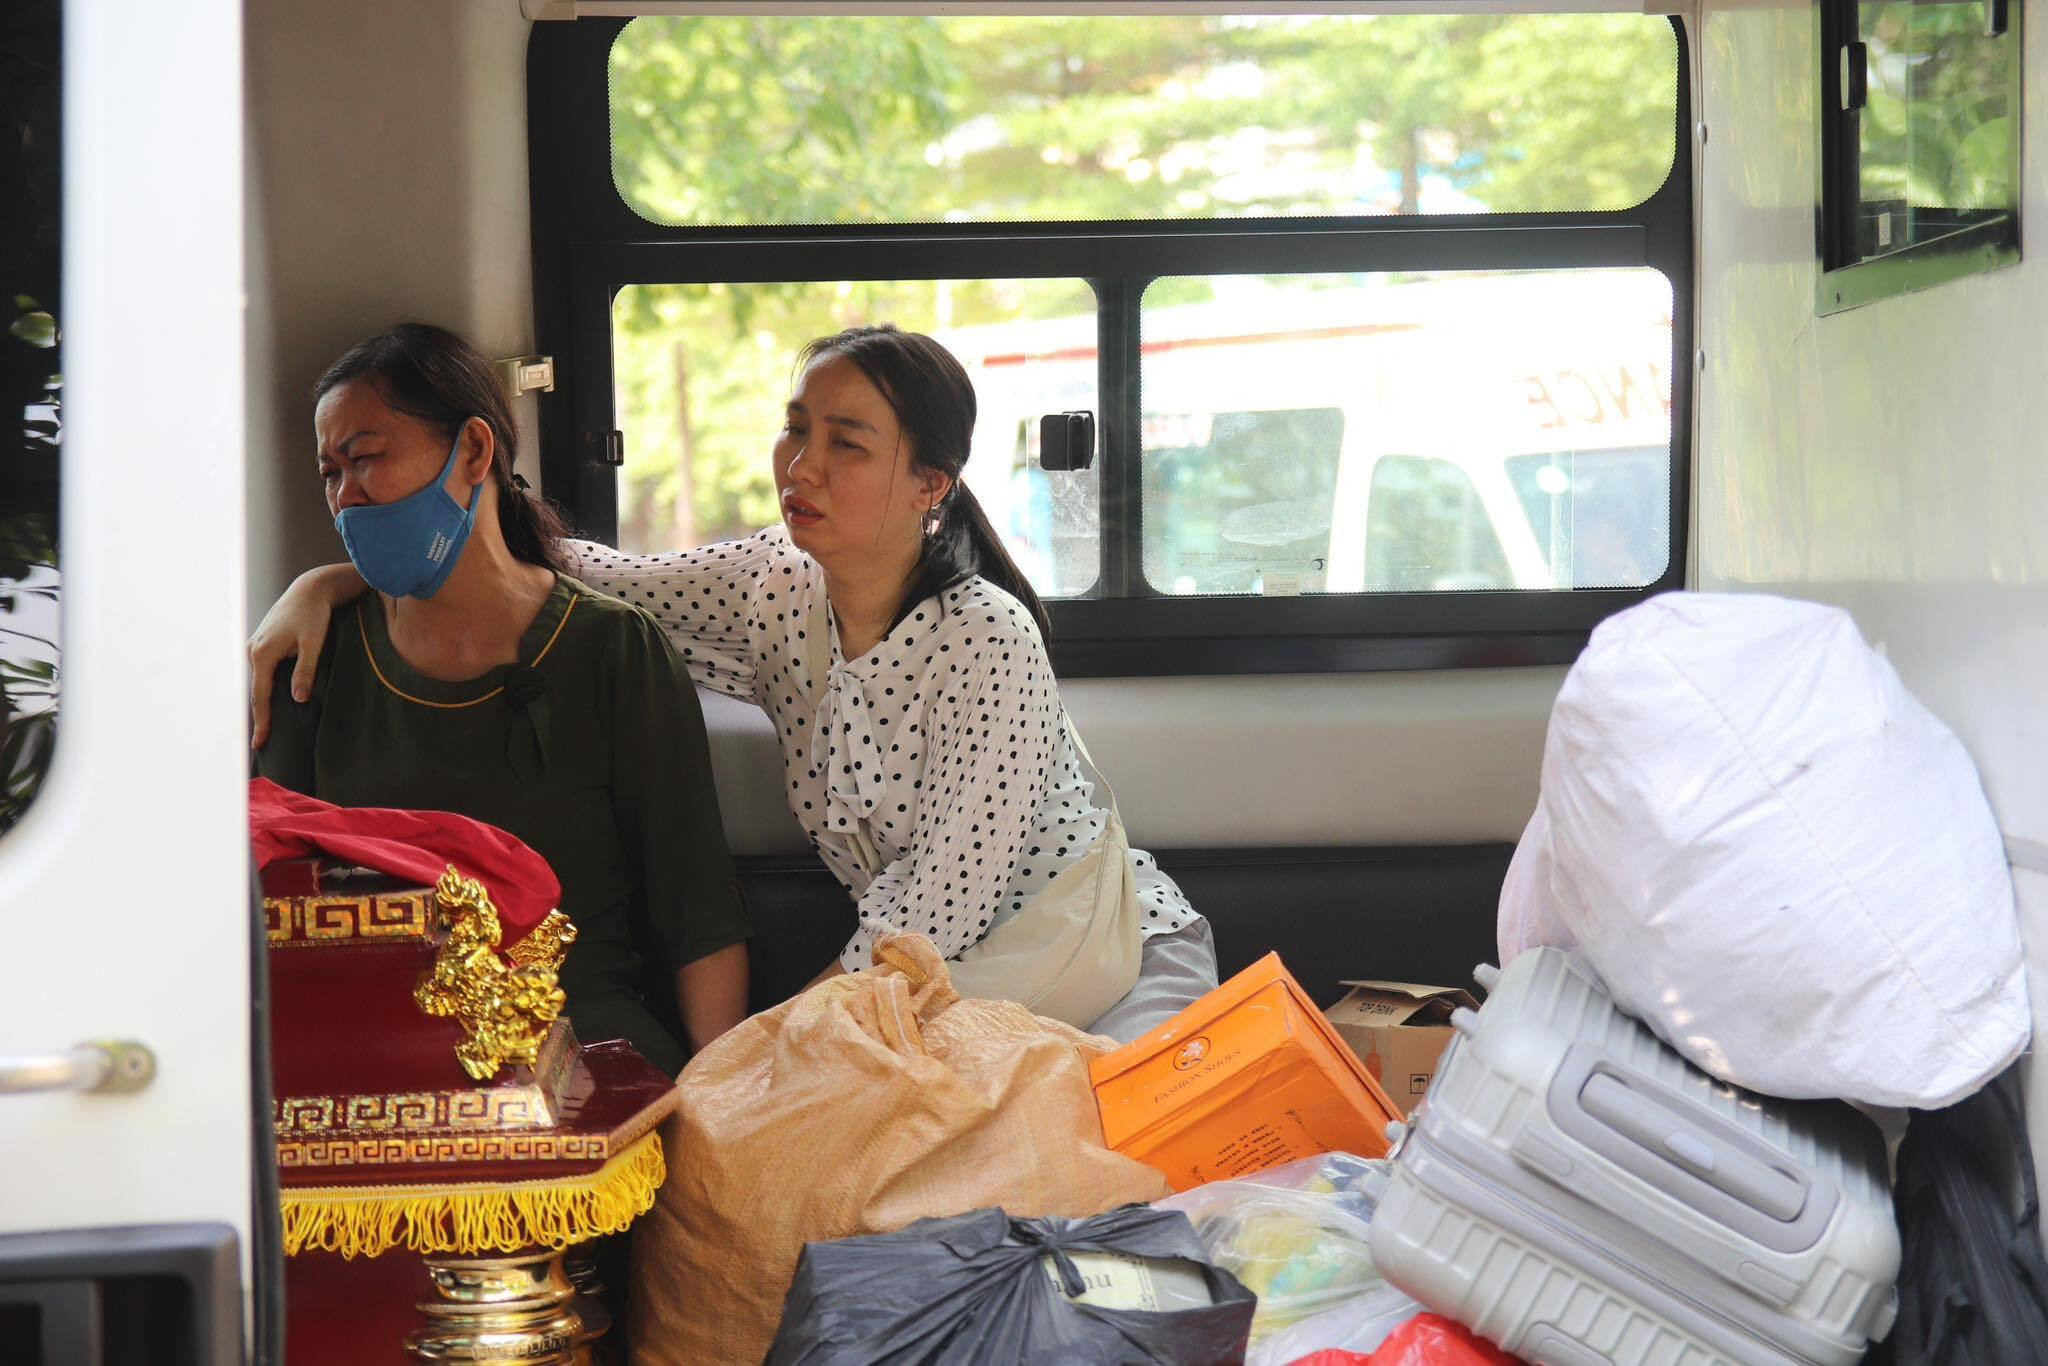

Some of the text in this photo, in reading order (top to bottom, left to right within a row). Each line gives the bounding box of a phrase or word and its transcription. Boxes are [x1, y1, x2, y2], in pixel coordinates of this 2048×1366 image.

[1371, 1003, 1398, 1016] DRINK
[1153, 1048, 1241, 1104] FASHION SHOES
